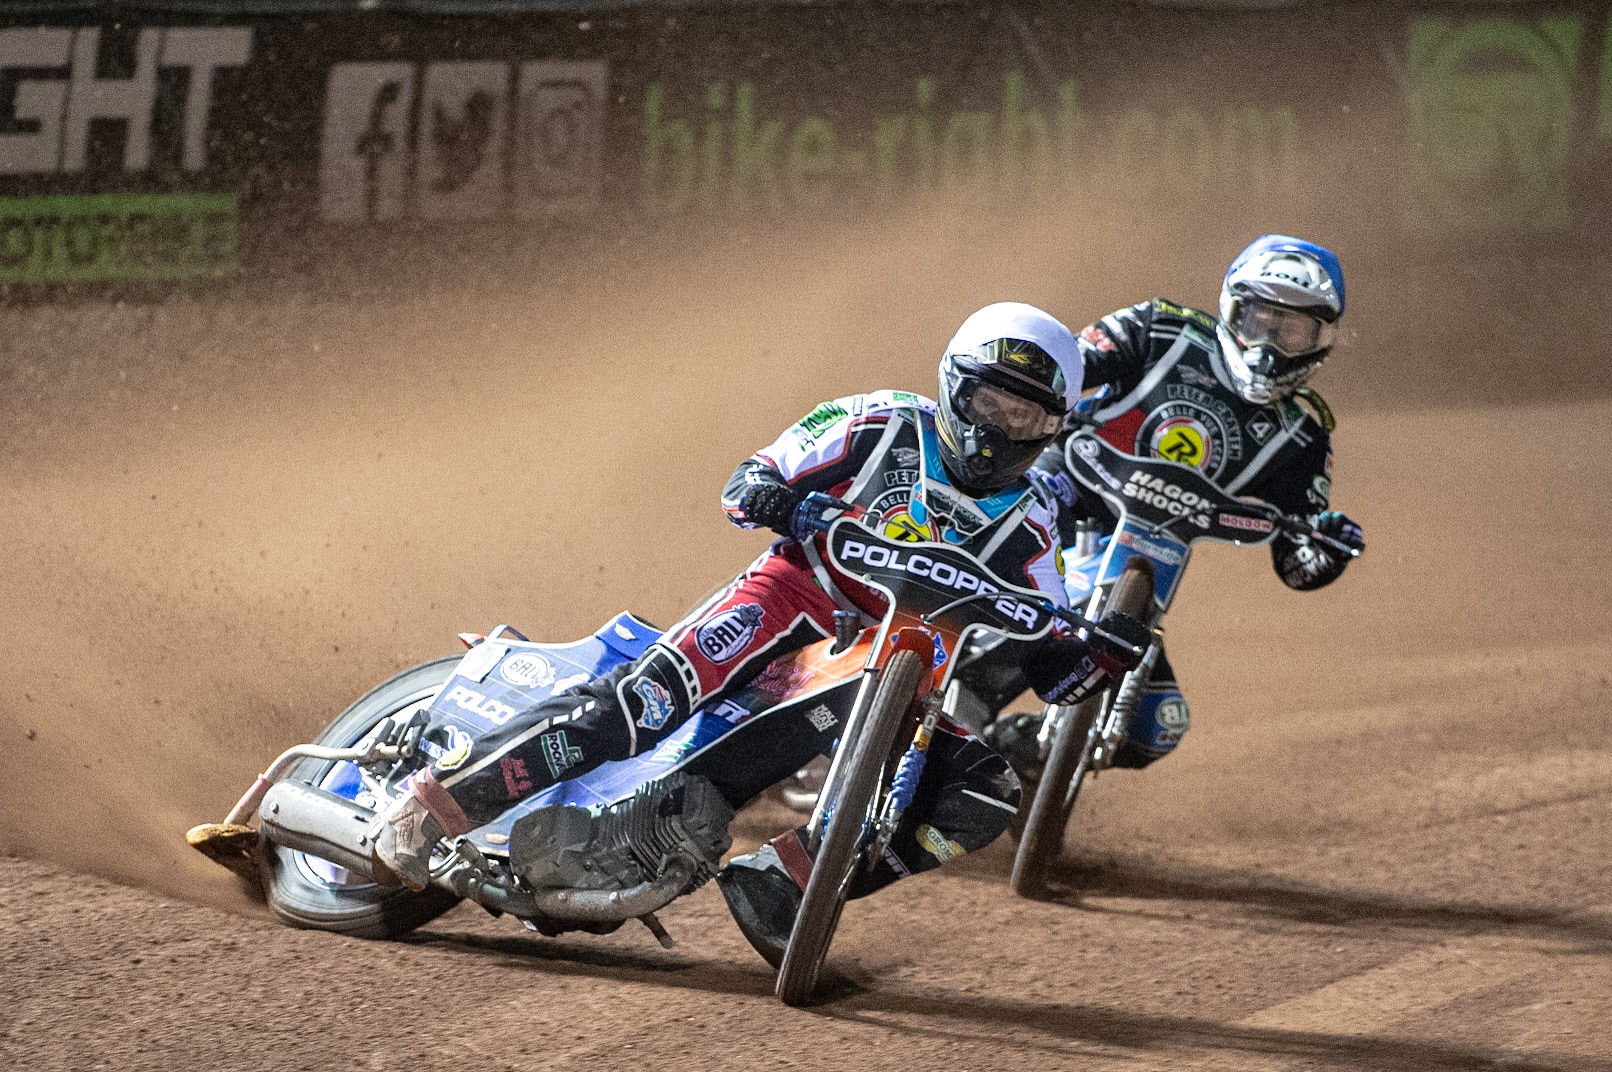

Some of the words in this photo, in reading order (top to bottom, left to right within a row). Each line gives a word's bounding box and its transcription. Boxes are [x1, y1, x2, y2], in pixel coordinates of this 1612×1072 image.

[0, 27, 253, 173] GHT
[643, 72, 1298, 206] bike-rightcom
[880, 493, 909, 508] BELL
[884, 469, 919, 486] PET
[841, 540, 1039, 630] POLCOPPER
[444, 685, 516, 725] POLCO
